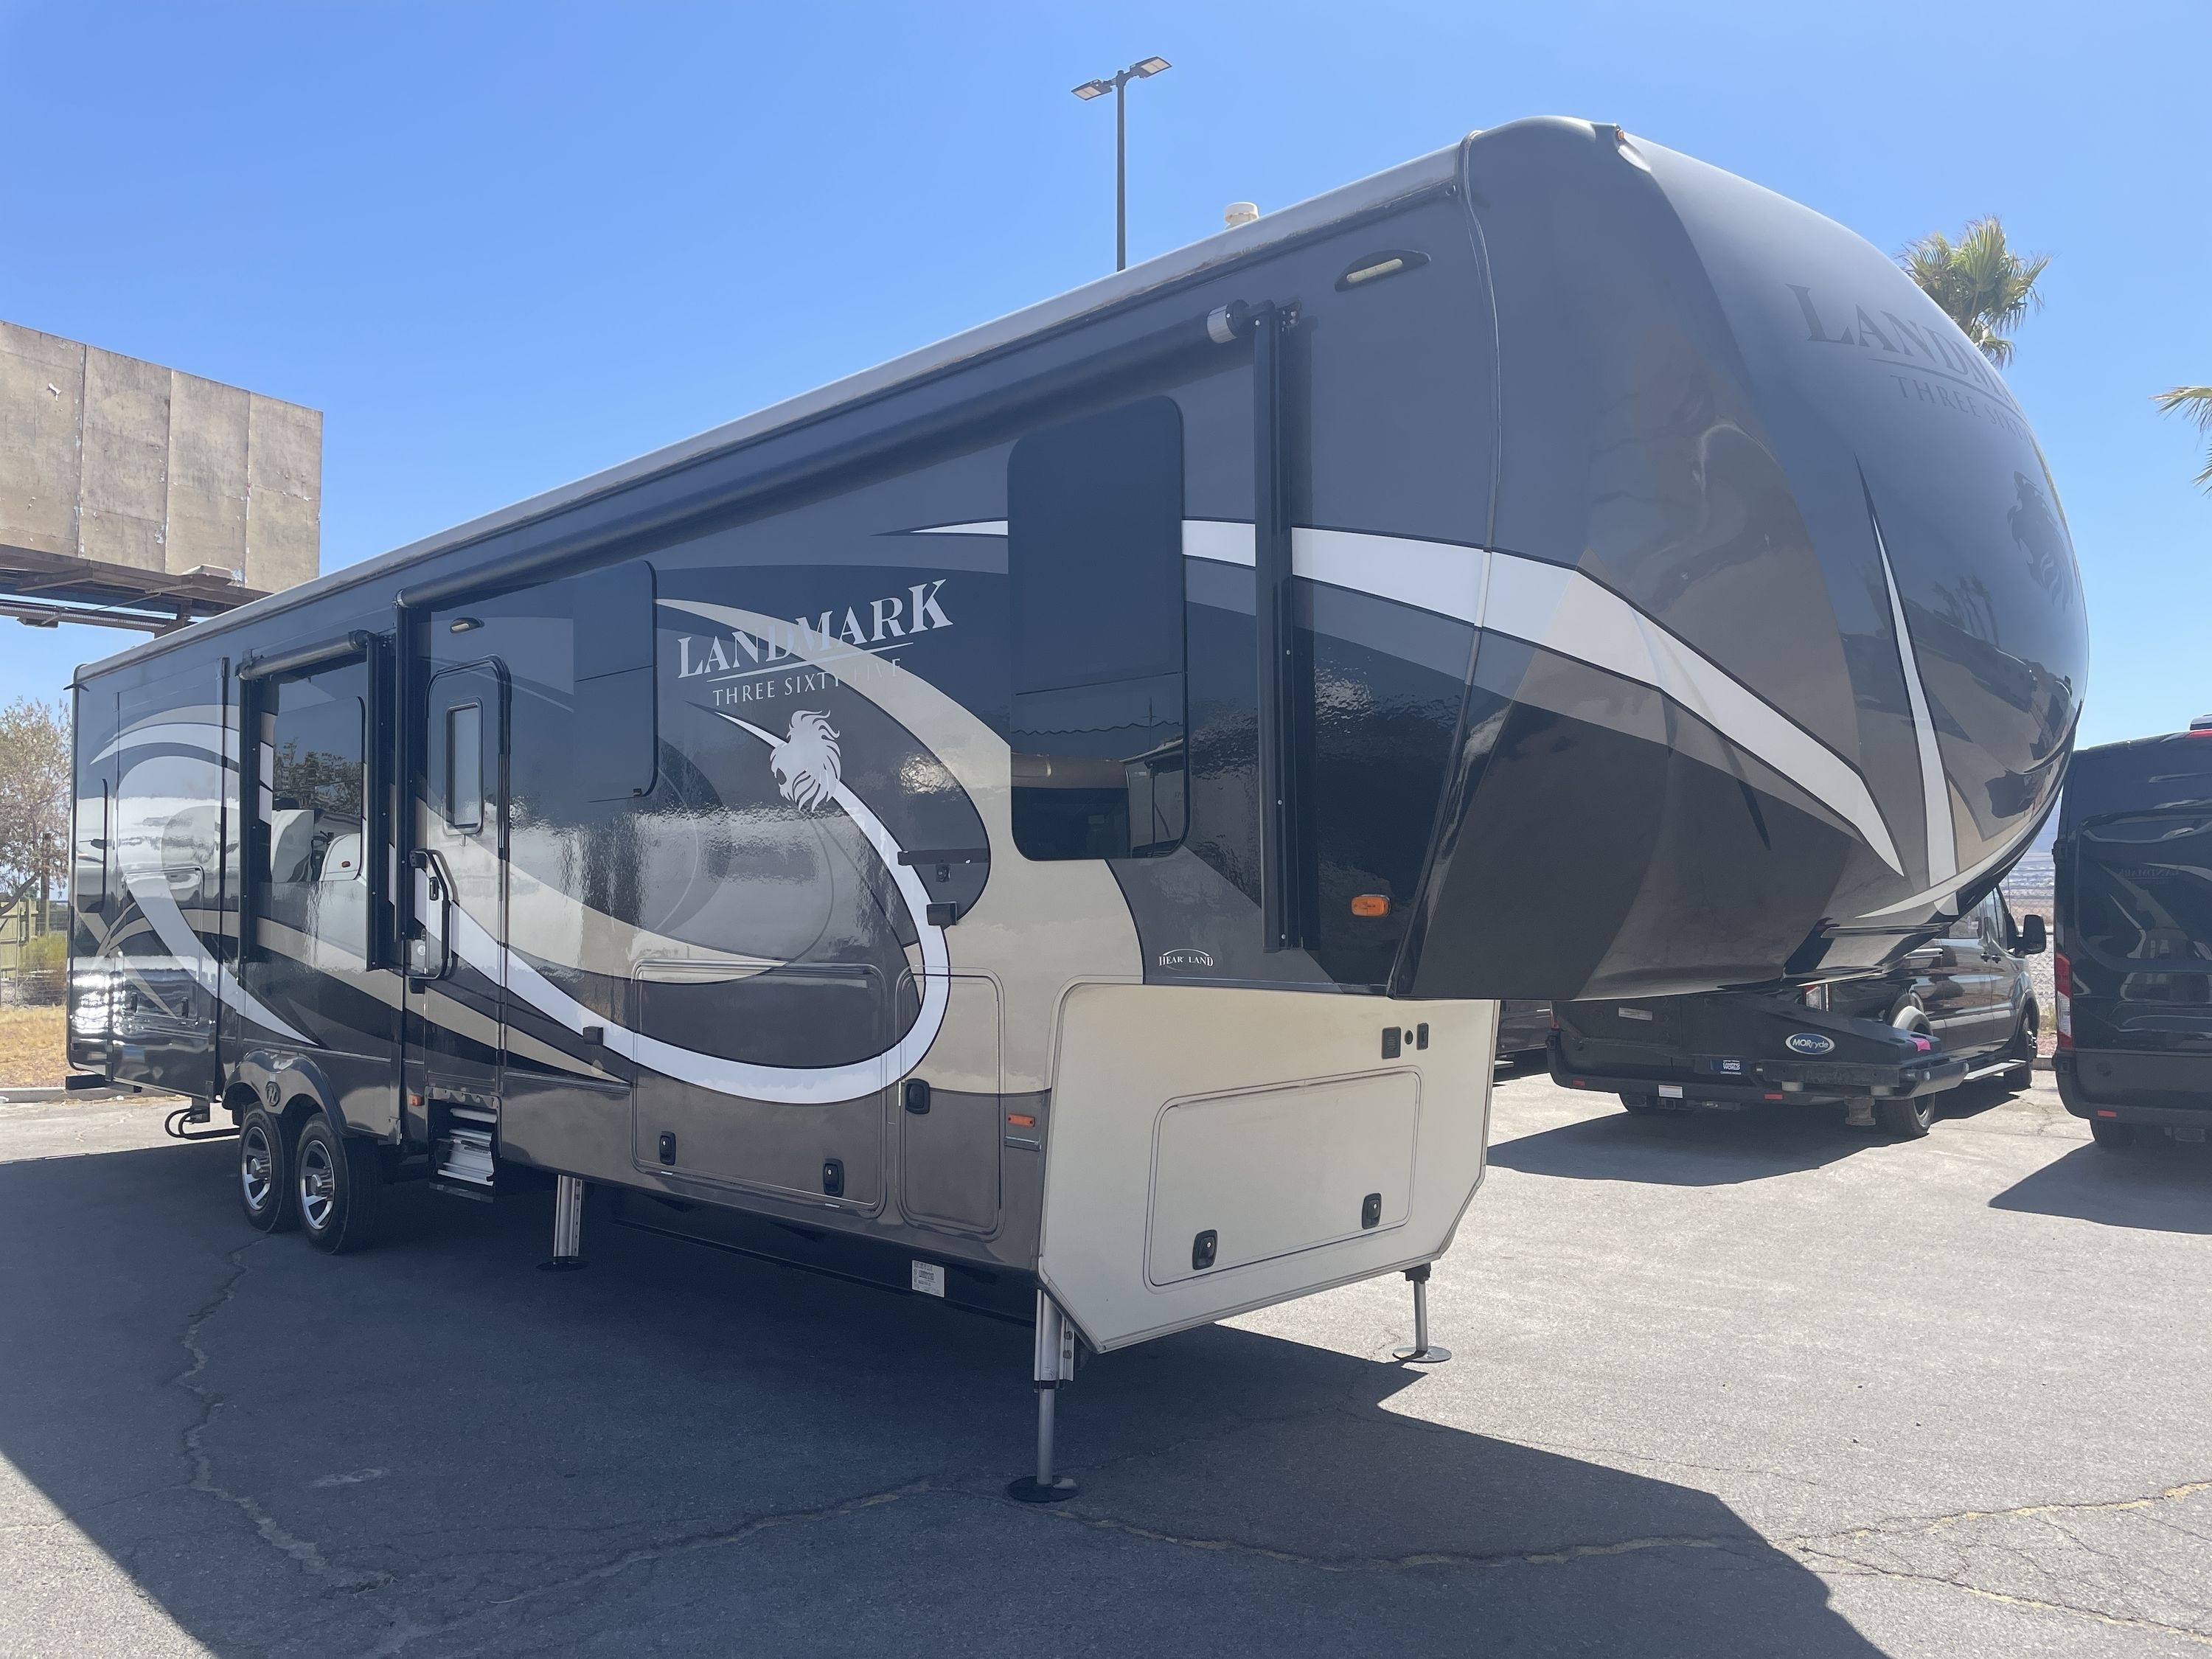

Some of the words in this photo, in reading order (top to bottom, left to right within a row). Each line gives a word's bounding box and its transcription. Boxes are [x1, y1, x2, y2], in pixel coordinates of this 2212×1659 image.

[1890, 375, 1981, 417] THREE
[678, 579, 954, 678] LANDMARK
[712, 680, 776, 706] THREE
[785, 669, 842, 696] SIXTY
[1792, 1038, 1829, 1048] MORryde
